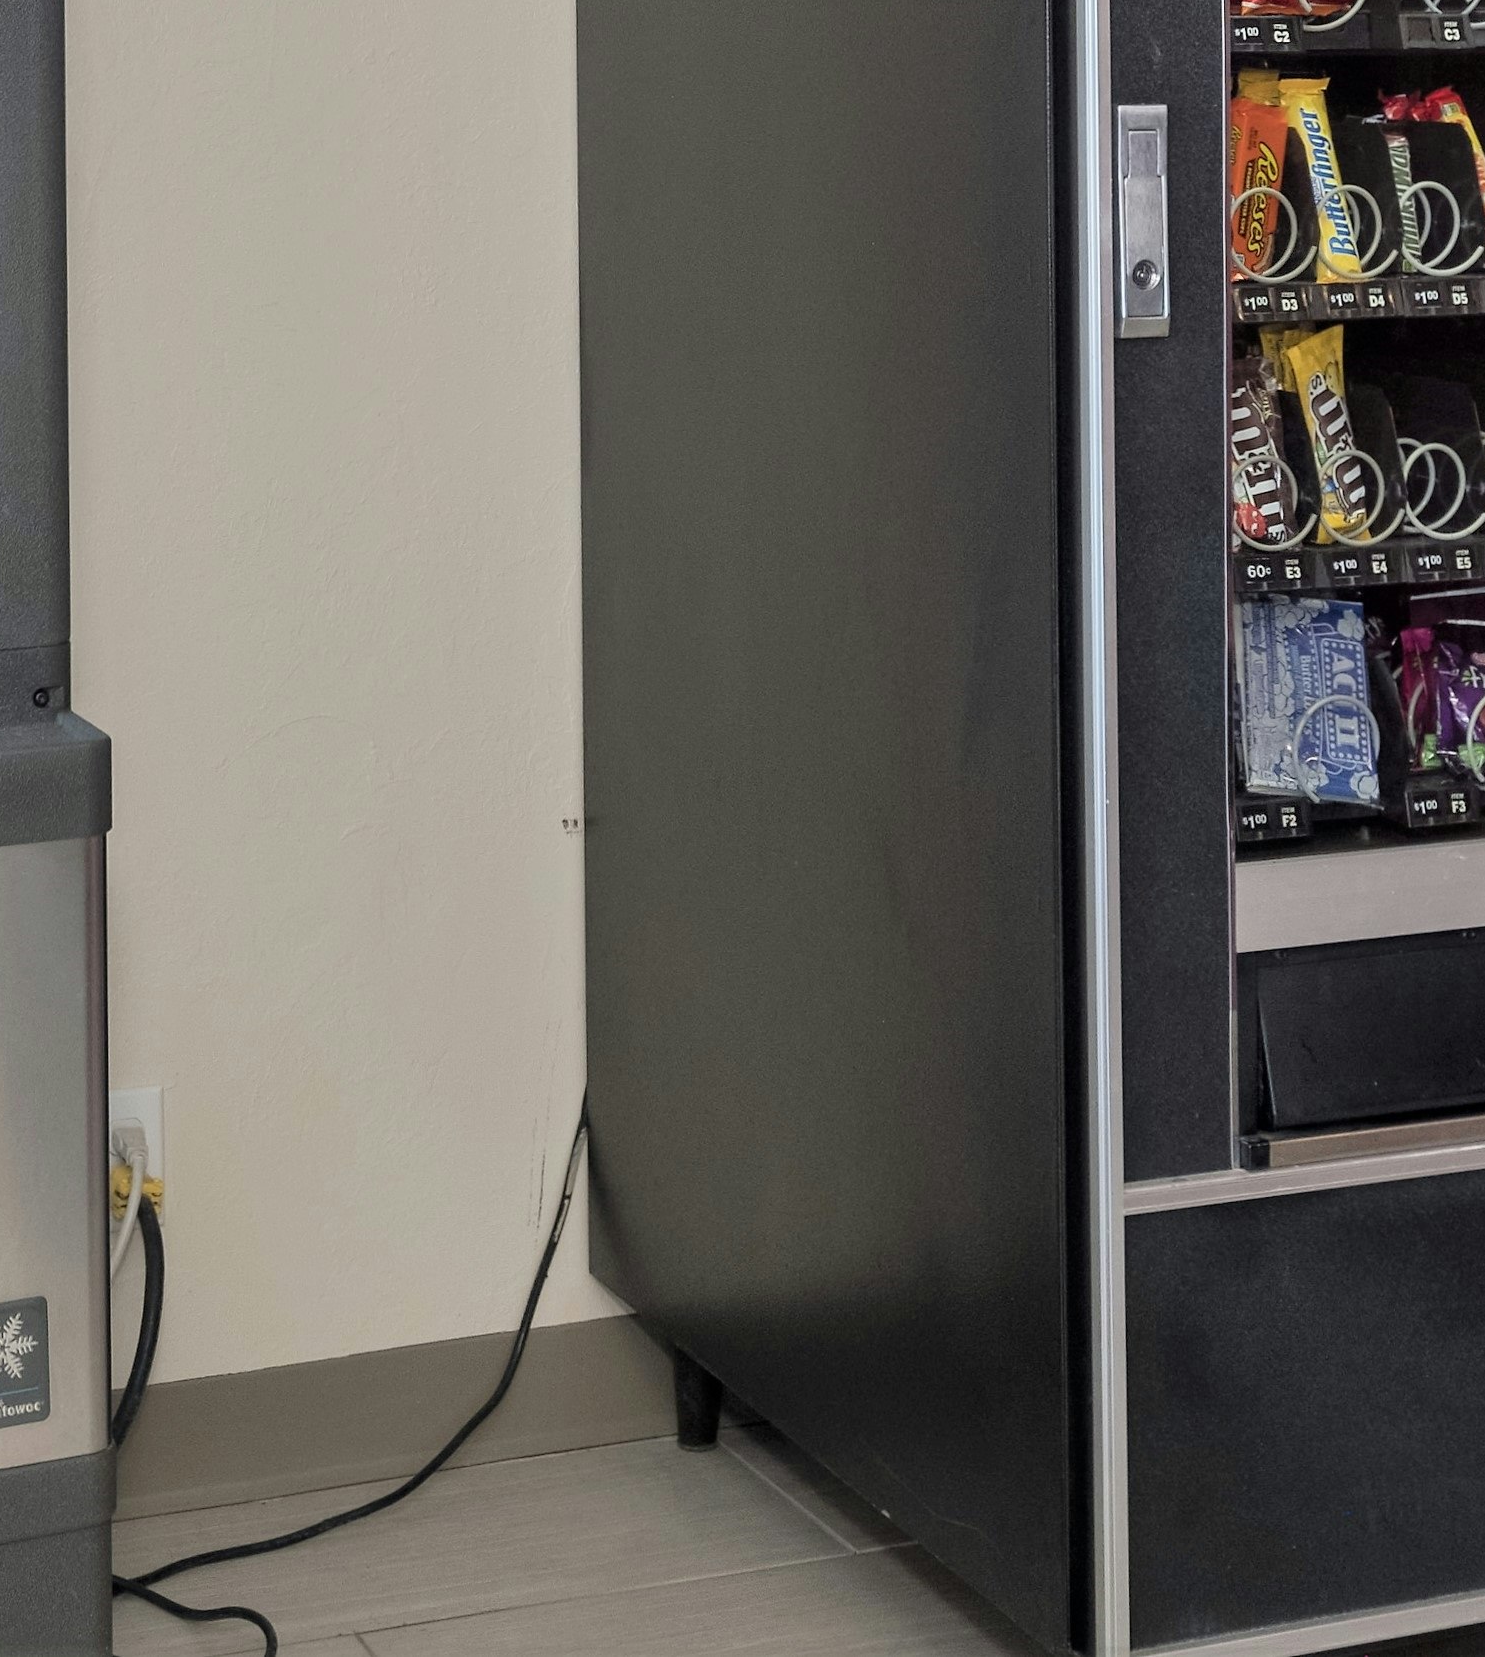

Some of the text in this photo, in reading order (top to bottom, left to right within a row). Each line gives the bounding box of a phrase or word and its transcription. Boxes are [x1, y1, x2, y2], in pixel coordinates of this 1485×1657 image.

[1274, 31, 1291, 43] C2
[1444, 28, 1460, 41] C3
[1300, 107, 1357, 256] Butterfinger
[1246, 142, 1279, 257] Reese's
[1282, 298, 1299, 311] D3
[1369, 294, 1386, 307] D4
[1452, 292, 1468, 305] D5
[1372, 561, 1388, 574] E4
[1456, 557, 1472, 570] E5
[1285, 566, 1301, 579] E3
[1300, 655, 1314, 736] Butter Loers
[1452, 801, 1466, 813] F3
[1282, 815, 1298, 828] F2
